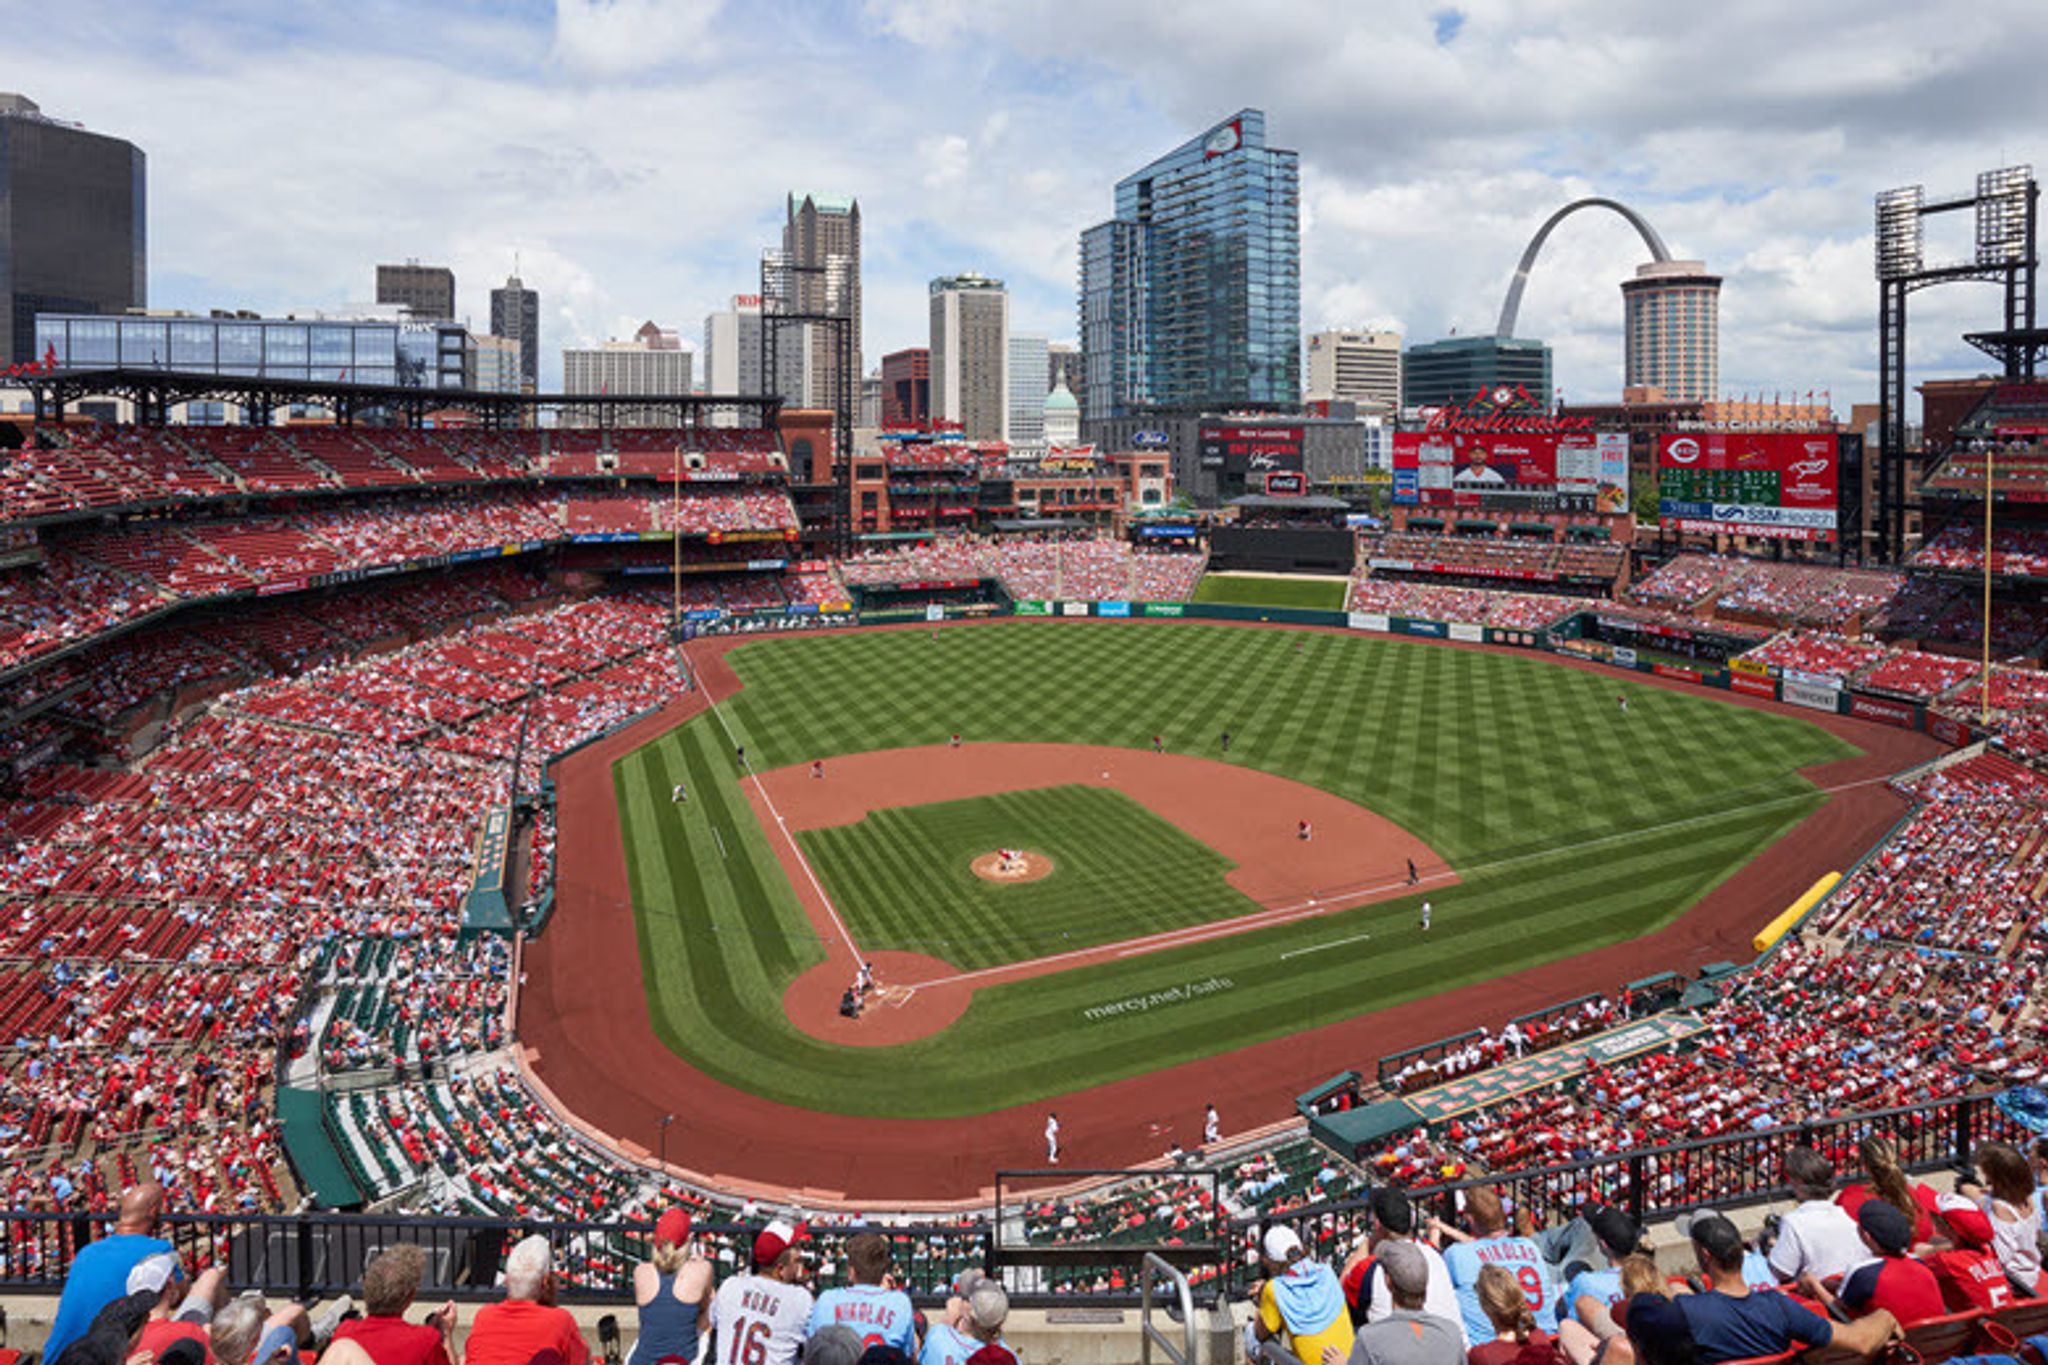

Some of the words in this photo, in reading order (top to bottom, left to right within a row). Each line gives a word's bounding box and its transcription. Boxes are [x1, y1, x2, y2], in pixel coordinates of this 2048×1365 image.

[1418, 404, 1596, 433] Budweiser
[1678, 420, 1725, 430] WORLD
[1728, 420, 1819, 430] CHAMPIONS
[1681, 519, 1724, 532] BROWN
[1084, 977, 1234, 1020] mercy.net/safe
[730, 1315, 772, 1365] 16
